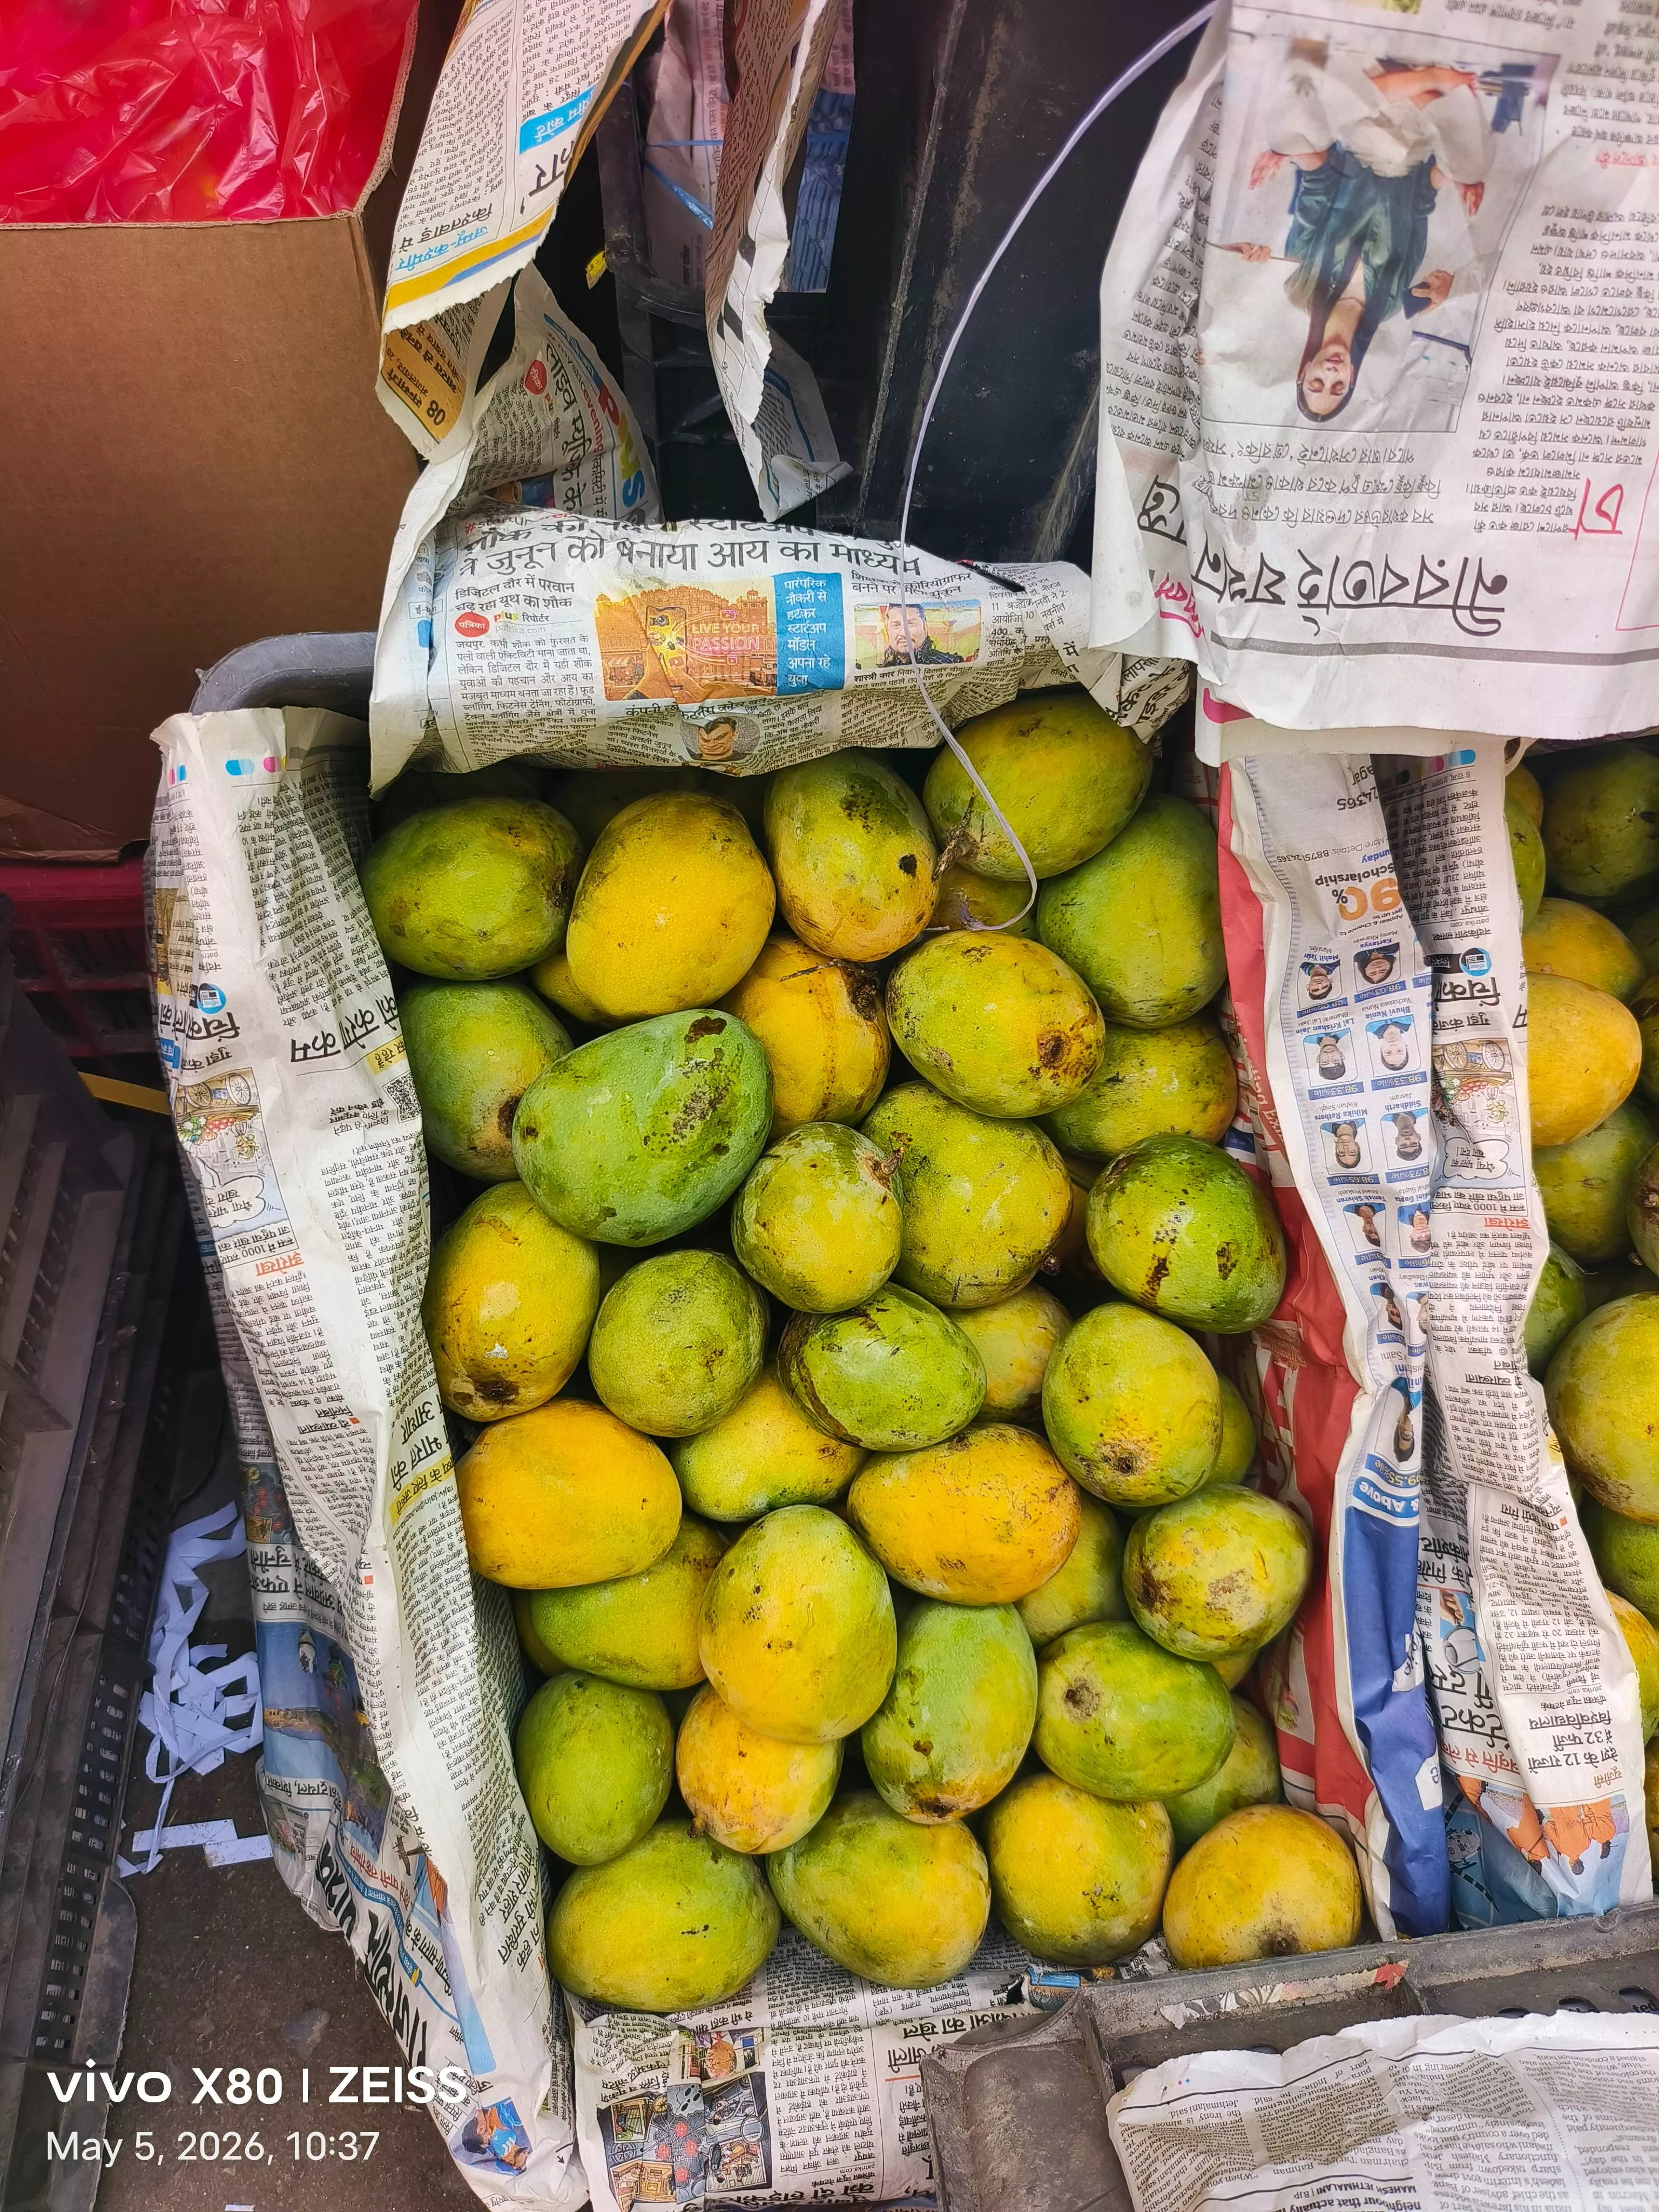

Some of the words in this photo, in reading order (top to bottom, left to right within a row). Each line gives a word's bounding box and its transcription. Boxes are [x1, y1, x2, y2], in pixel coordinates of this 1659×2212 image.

[532, 117, 564, 141] कोर्ट
[395, 226, 488, 271] जम्मू-कश्मीर
[399, 236, 414, 253] में
[427, 400, 446, 426] 08
[1283, 508, 1298, 528] কি
[486, 542, 557, 575] जुनून
[565, 529, 608, 563] को
[708, 541, 769, 568] आय
[778, 541, 820, 563] का
[1191, 532, 1286, 604] যখন
[455, 583, 499, 600] डिजिटल
[503, 578, 521, 589] दौर
[524, 575, 535, 588] में
[538, 578, 575, 592] परवान
[784, 578, 826, 590] पारंपरिक
[852, 582, 880, 594] बनने
[882, 583, 896, 595] पर
[786, 591, 814, 605] नौकरी
[818, 591, 827, 602] से
[1297, 550, 1507, 637] নীরবতাই
[478, 600, 496, 611] रहा
[500, 594, 520, 608] यूथ
[524, 594, 539, 608] का
[543, 596, 572, 609] शौक
[494, 611, 519, 622] plus
[522, 612, 549, 623] रिपोर्टर
[786, 608, 815, 621] हटकर
[458, 621, 485, 630] पत्रिका
[495, 624, 547, 634] patrika.com
[692, 623, 719, 633] LIVE
[723, 623, 759, 633] YOUR
[786, 621, 826, 634] स्टार्टअप
[490, 639, 508, 649] कभी
[535, 638, 545, 646] को
[550, 637, 576, 648] फुरसत
[580, 635, 588, 643] के
[693, 637, 760, 650] PASSION
[787, 639, 815, 652] मॉडल
[476, 650, 495, 660] वाली
[538, 649, 554, 658] माना
[557, 648, 576, 657] जाता
[458, 664, 483, 675] लेकिन
[488, 662, 520, 673] डिजिटल
[525, 660, 538, 671] दौर
[555, 659, 569, 669] यही
[787, 657, 814, 670] अपना
[818, 657, 831, 669] रहे
[786, 675, 808, 686] युवा
[1332, 844, 1363, 855] Details:
[1365, 838, 1384, 848] More
[1314, 862, 1395, 887] Scholarship
[1380, 914, 1403, 925] Appear
[1348, 922, 1371, 933] Chance
[1365, 1009, 1387, 1020] Nunia
[1389, 1006, 1411, 1018] Bhuvi
[1313, 1020, 1341, 1032] Krishan
[291, 1030, 341, 1063] कम
[1390, 1091, 1413, 1101] Jasram
[1385, 1100, 1421, 1111] Siddharth
[1314, 1112, 1341, 1121] Rathore
[1483, 1217, 1529, 1230] झरोखा
[241, 1244, 266, 1257] 1000
[254, 1252, 303, 1277] झरोखा
[1380, 1351, 1402, 1362] Saini
[401, 1401, 435, 1445] आधार
[410, 1436, 442, 1470] भारत
[1359, 1481, 1406, 1512] Above
[1567, 1685, 1602, 1695] patrika.com
[1541, 1701, 1565, 1711] नेटवर्क
[1567, 1695, 1583, 1705] न्यूज
[1583, 1695, 1606, 1704] पत्रिका
[1528, 1710, 1611, 1730] विश्वविद्यालय
[1552, 1733, 1583, 1751] फर्जी
[1584, 1731, 1603, 1744] 32
[1604, 1728, 1613, 1743] में
[1563, 1753, 1581, 1765] 12
[1583, 1752, 1599, 1768] के
[1601, 1746, 1618, 1762] देश
[1527, 1755, 1562, 1773] राज्यों
[1594, 1766, 1622, 1788] यूजीसी
[903, 2022, 938, 2041] खेल
[941, 2018, 966, 2035] का
[1189, 2099, 1238, 2113] Jethmalani
[1251, 2095, 1272, 2105] said.
[1168, 2107, 1188, 2117] said.
[1198, 2111, 1222, 2122] irony
[1226, 2109, 1240, 2118] the
[1152, 2118, 1182, 2128] almost
[1186, 2116, 1194, 2126] is
[840, 2163, 875, 2174] patrika.com
[1273, 2161, 1314, 2176] Rahman
[1449, 2162, 1473, 2170] from
[1478, 2164, 1526, 2174] takedown
[1532, 2163, 1561, 2174] sharp
[853, 2171, 875, 2181] पत्रिका
